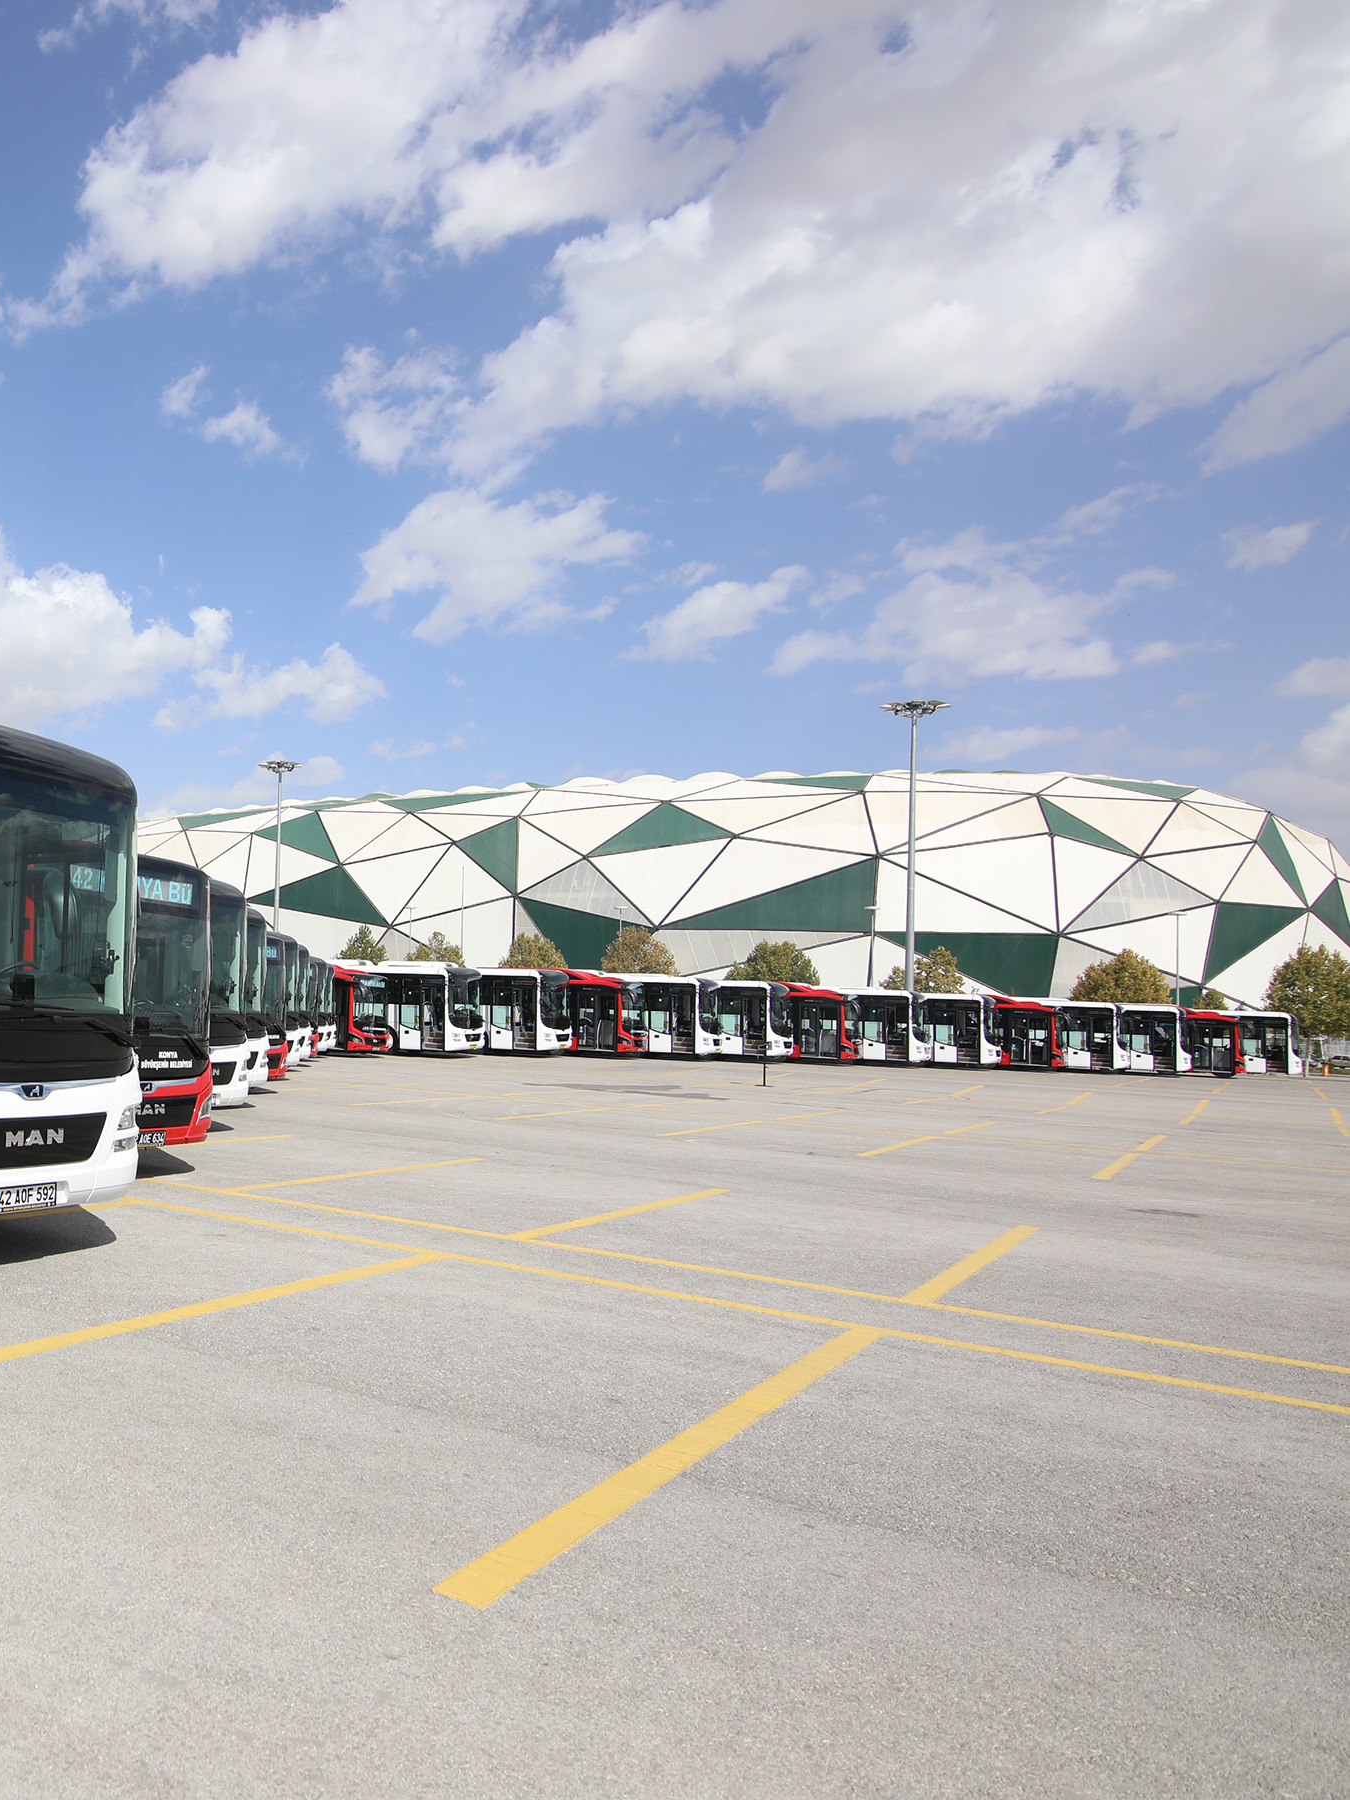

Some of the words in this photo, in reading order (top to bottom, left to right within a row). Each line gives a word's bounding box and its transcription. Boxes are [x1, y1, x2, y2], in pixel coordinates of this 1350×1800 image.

[73, 866, 93, 889] 42
[158, 1051, 178, 1059] KONYA
[5, 1127, 65, 1148] MAN
[14, 1187, 34, 1204] AOF
[36, 1185, 55, 1202] 592
